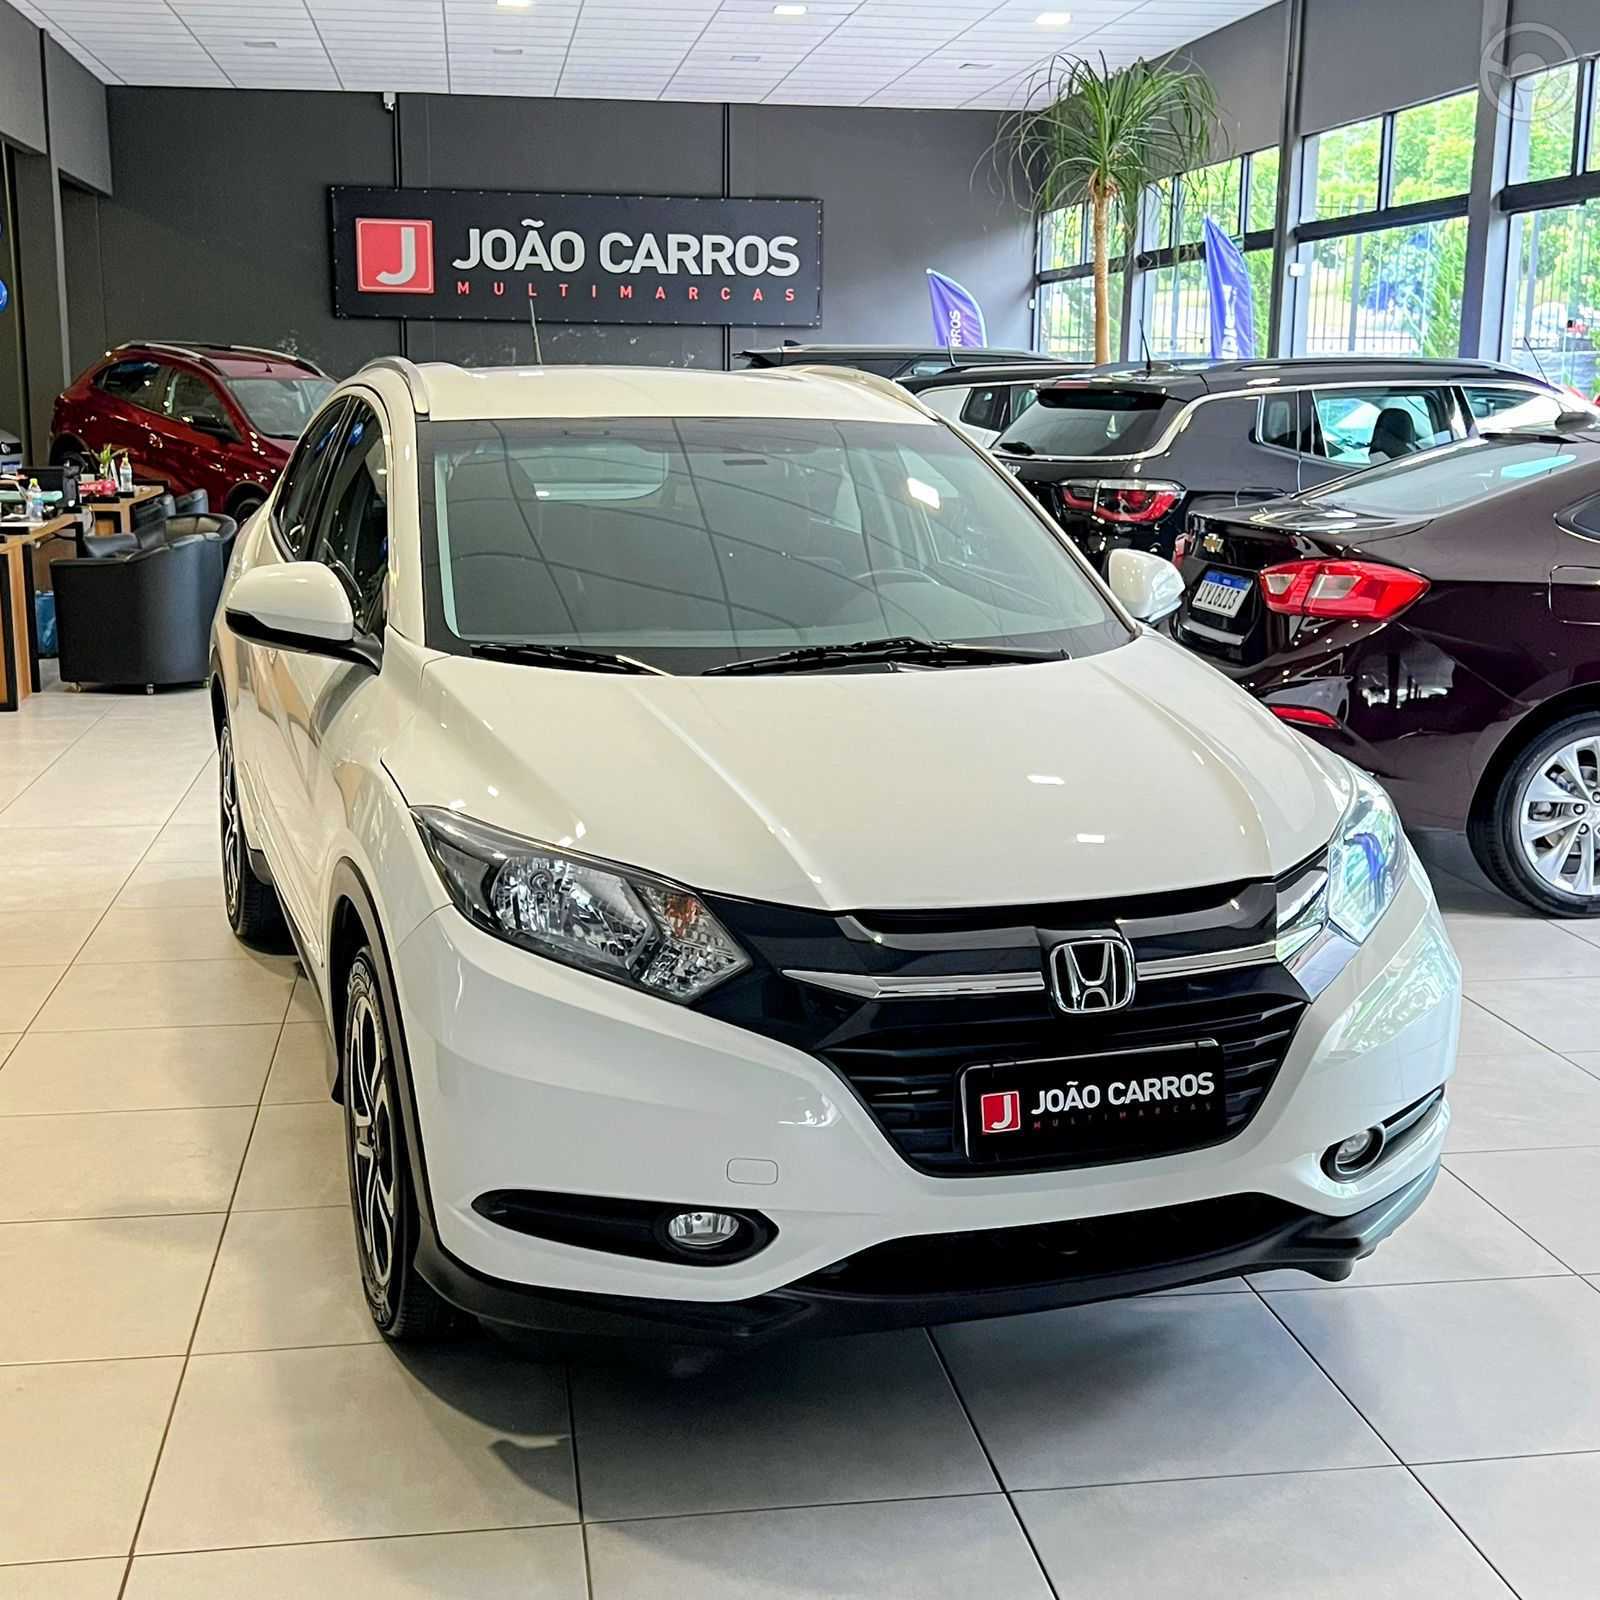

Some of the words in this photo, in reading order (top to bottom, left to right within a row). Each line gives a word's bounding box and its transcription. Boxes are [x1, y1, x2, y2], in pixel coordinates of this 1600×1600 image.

[375, 227, 417, 286] J
[452, 218, 586, 273] JOÃO
[599, 232, 800, 277] CARROS
[457, 281, 796, 302] MULTIMARCAS
[991, 1094, 1013, 1130] J
[1031, 1081, 1100, 1115] JOÃO
[1107, 1072, 1216, 1106] CARROS
